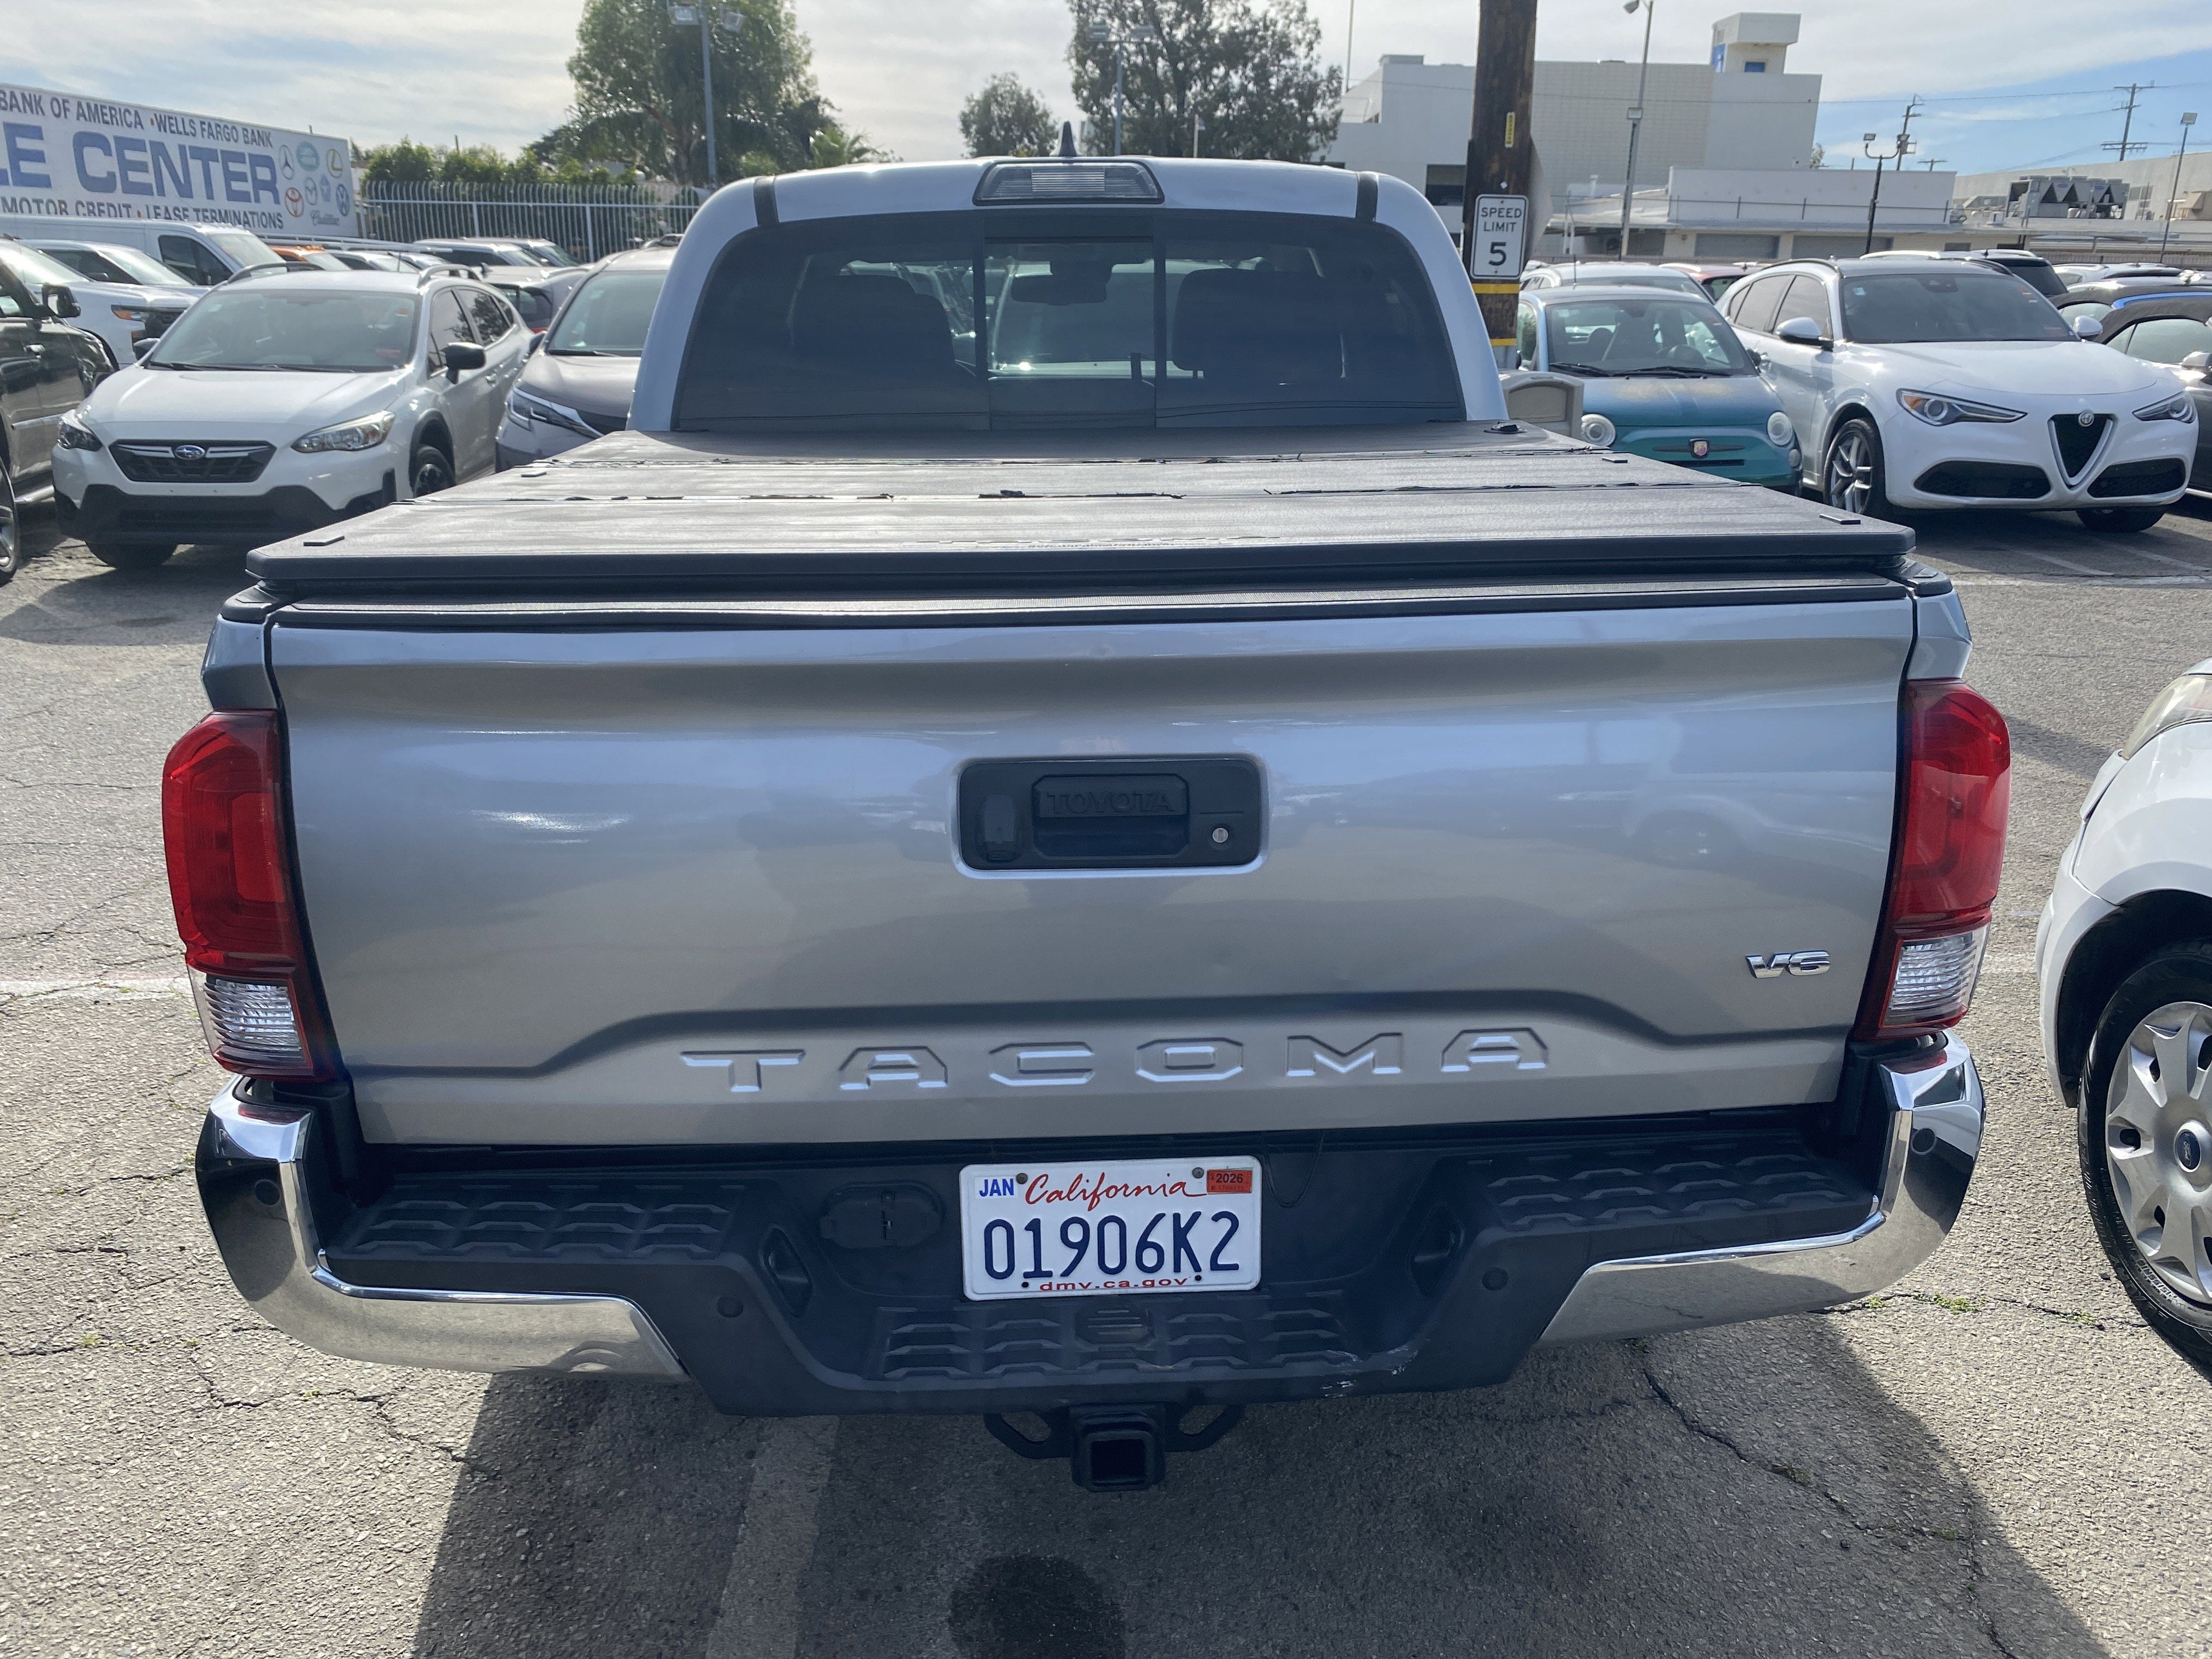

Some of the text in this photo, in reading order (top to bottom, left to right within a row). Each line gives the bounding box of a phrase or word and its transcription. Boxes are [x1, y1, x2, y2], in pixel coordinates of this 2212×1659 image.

[0, 89, 273, 149] BANK OF AMERICA WELLS FARGO BANK
[72, 131, 281, 205] CENTER
[1, 196, 284, 229] MOTOR CREDIT LEASE TERMINATIONS
[1481, 207, 1522, 218] SPEED
[1483, 222, 1516, 232] LIMIT
[1488, 241, 1507, 266] 5
[1046, 790, 1175, 815] TOYOTA
[1745, 950, 1831, 979] V6
[680, 1028, 1548, 1092] TACOMA
[979, 1178, 1014, 1198] JAN
[1025, 1172, 1207, 1211] California
[1216, 1173, 1244, 1183] 2026
[984, 1211, 1240, 1280] 01906K2
[1040, 1277, 1188, 1291] dmv.ca.gov
